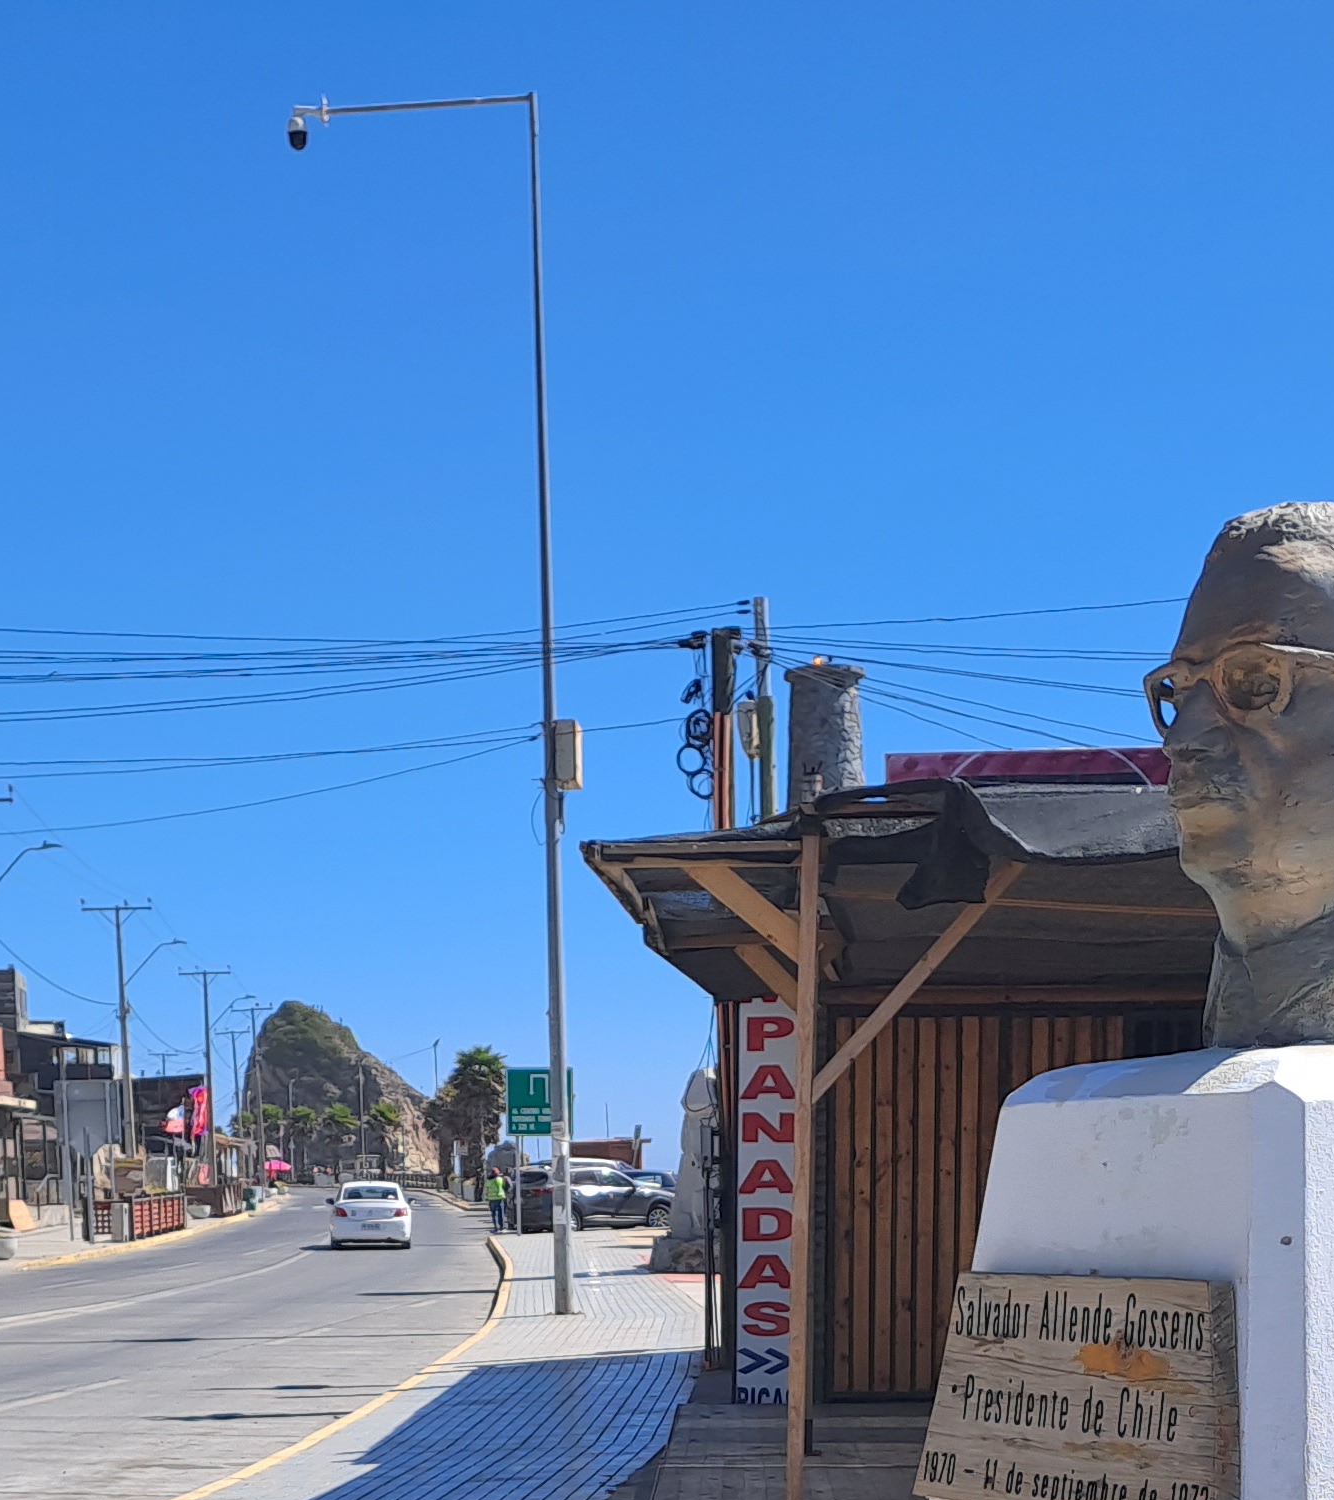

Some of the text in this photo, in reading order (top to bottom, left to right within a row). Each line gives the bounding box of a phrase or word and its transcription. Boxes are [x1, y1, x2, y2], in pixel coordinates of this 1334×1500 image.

[955, 1285, 1205, 1351] Salvador Allende Gossens
[963, 1373, 1178, 1442] Presidente de Chile
[923, 1450, 956, 1486] 1970
[1006, 1462, 1023, 1495] de
